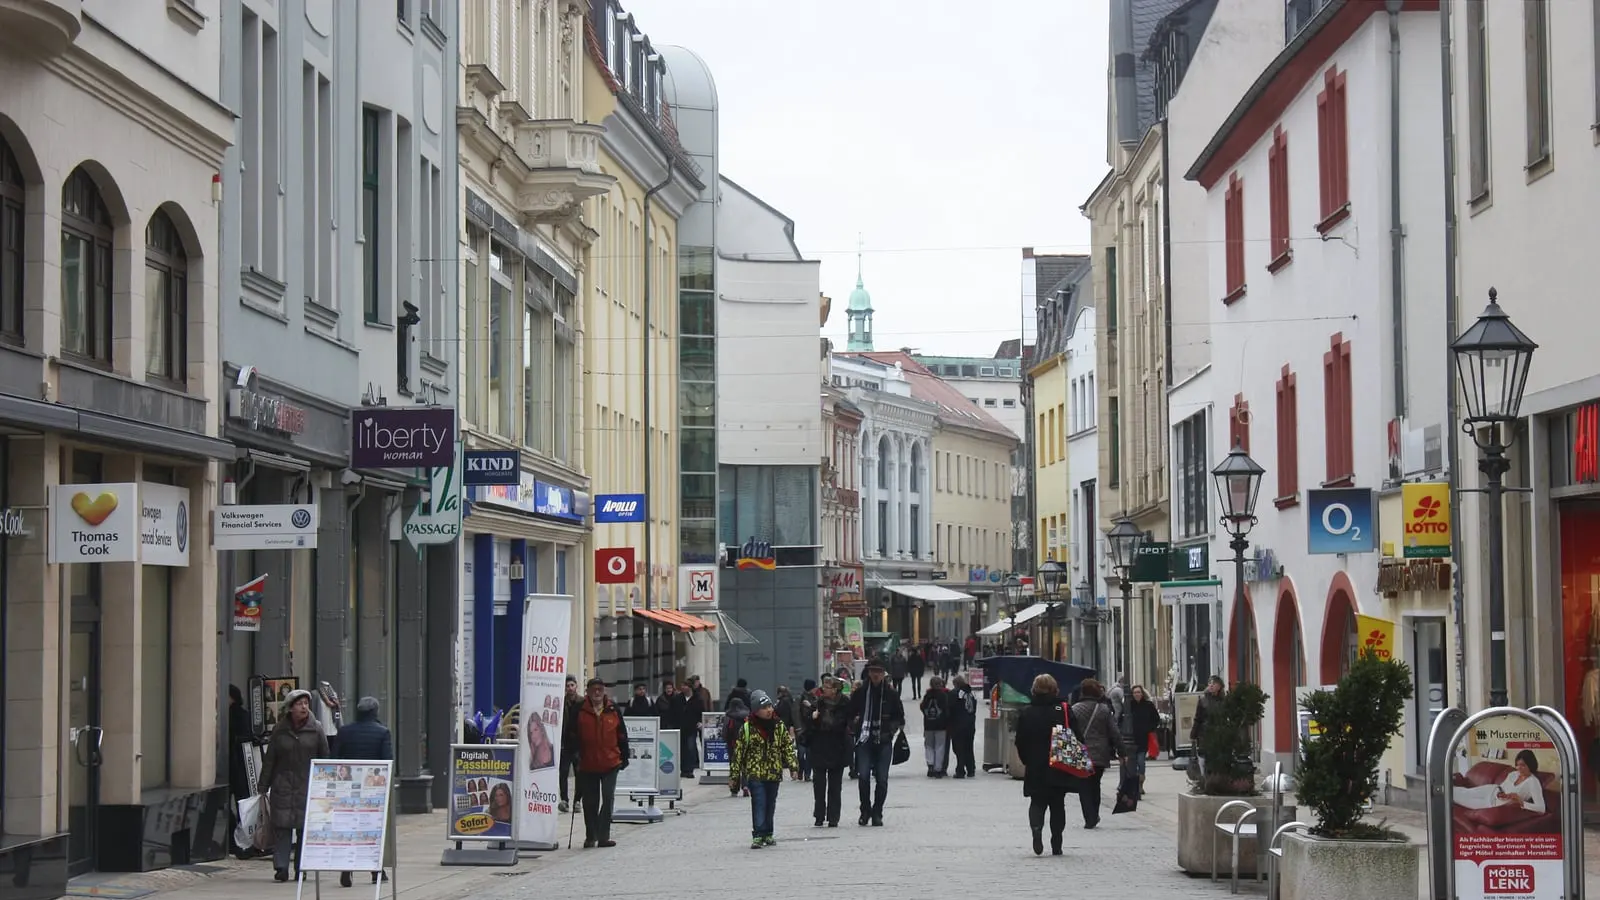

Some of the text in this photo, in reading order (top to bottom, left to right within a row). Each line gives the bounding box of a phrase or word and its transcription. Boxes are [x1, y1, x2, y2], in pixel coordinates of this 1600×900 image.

[359, 417, 447, 454] liberty
[383, 451, 423, 460] woman
[467, 457, 514, 471] KIND
[602, 500, 638, 513] APOLLO
[4, 508, 25, 535] Cook
[221, 512, 264, 520] Volkswagen
[254, 520, 282, 528] Services
[406, 523, 457, 535] PASSAGE
[1405, 522, 1448, 534] LOTTO
[72, 531, 119, 542] Thomas
[155, 528, 172, 546] Services
[80, 543, 110, 555] Cook
[743, 536, 774, 558] dm
[697, 580, 708, 592] M
[531, 636, 558, 654] PASS
[1489, 729, 1541, 741] Musterring
[461, 751, 489, 760] Digitale
[455, 759, 511, 770] Passbilder
[460, 816, 489, 829] Sofort
[1489, 867, 1529, 878] MÖBEL
[1489, 878, 1530, 889] LENK
